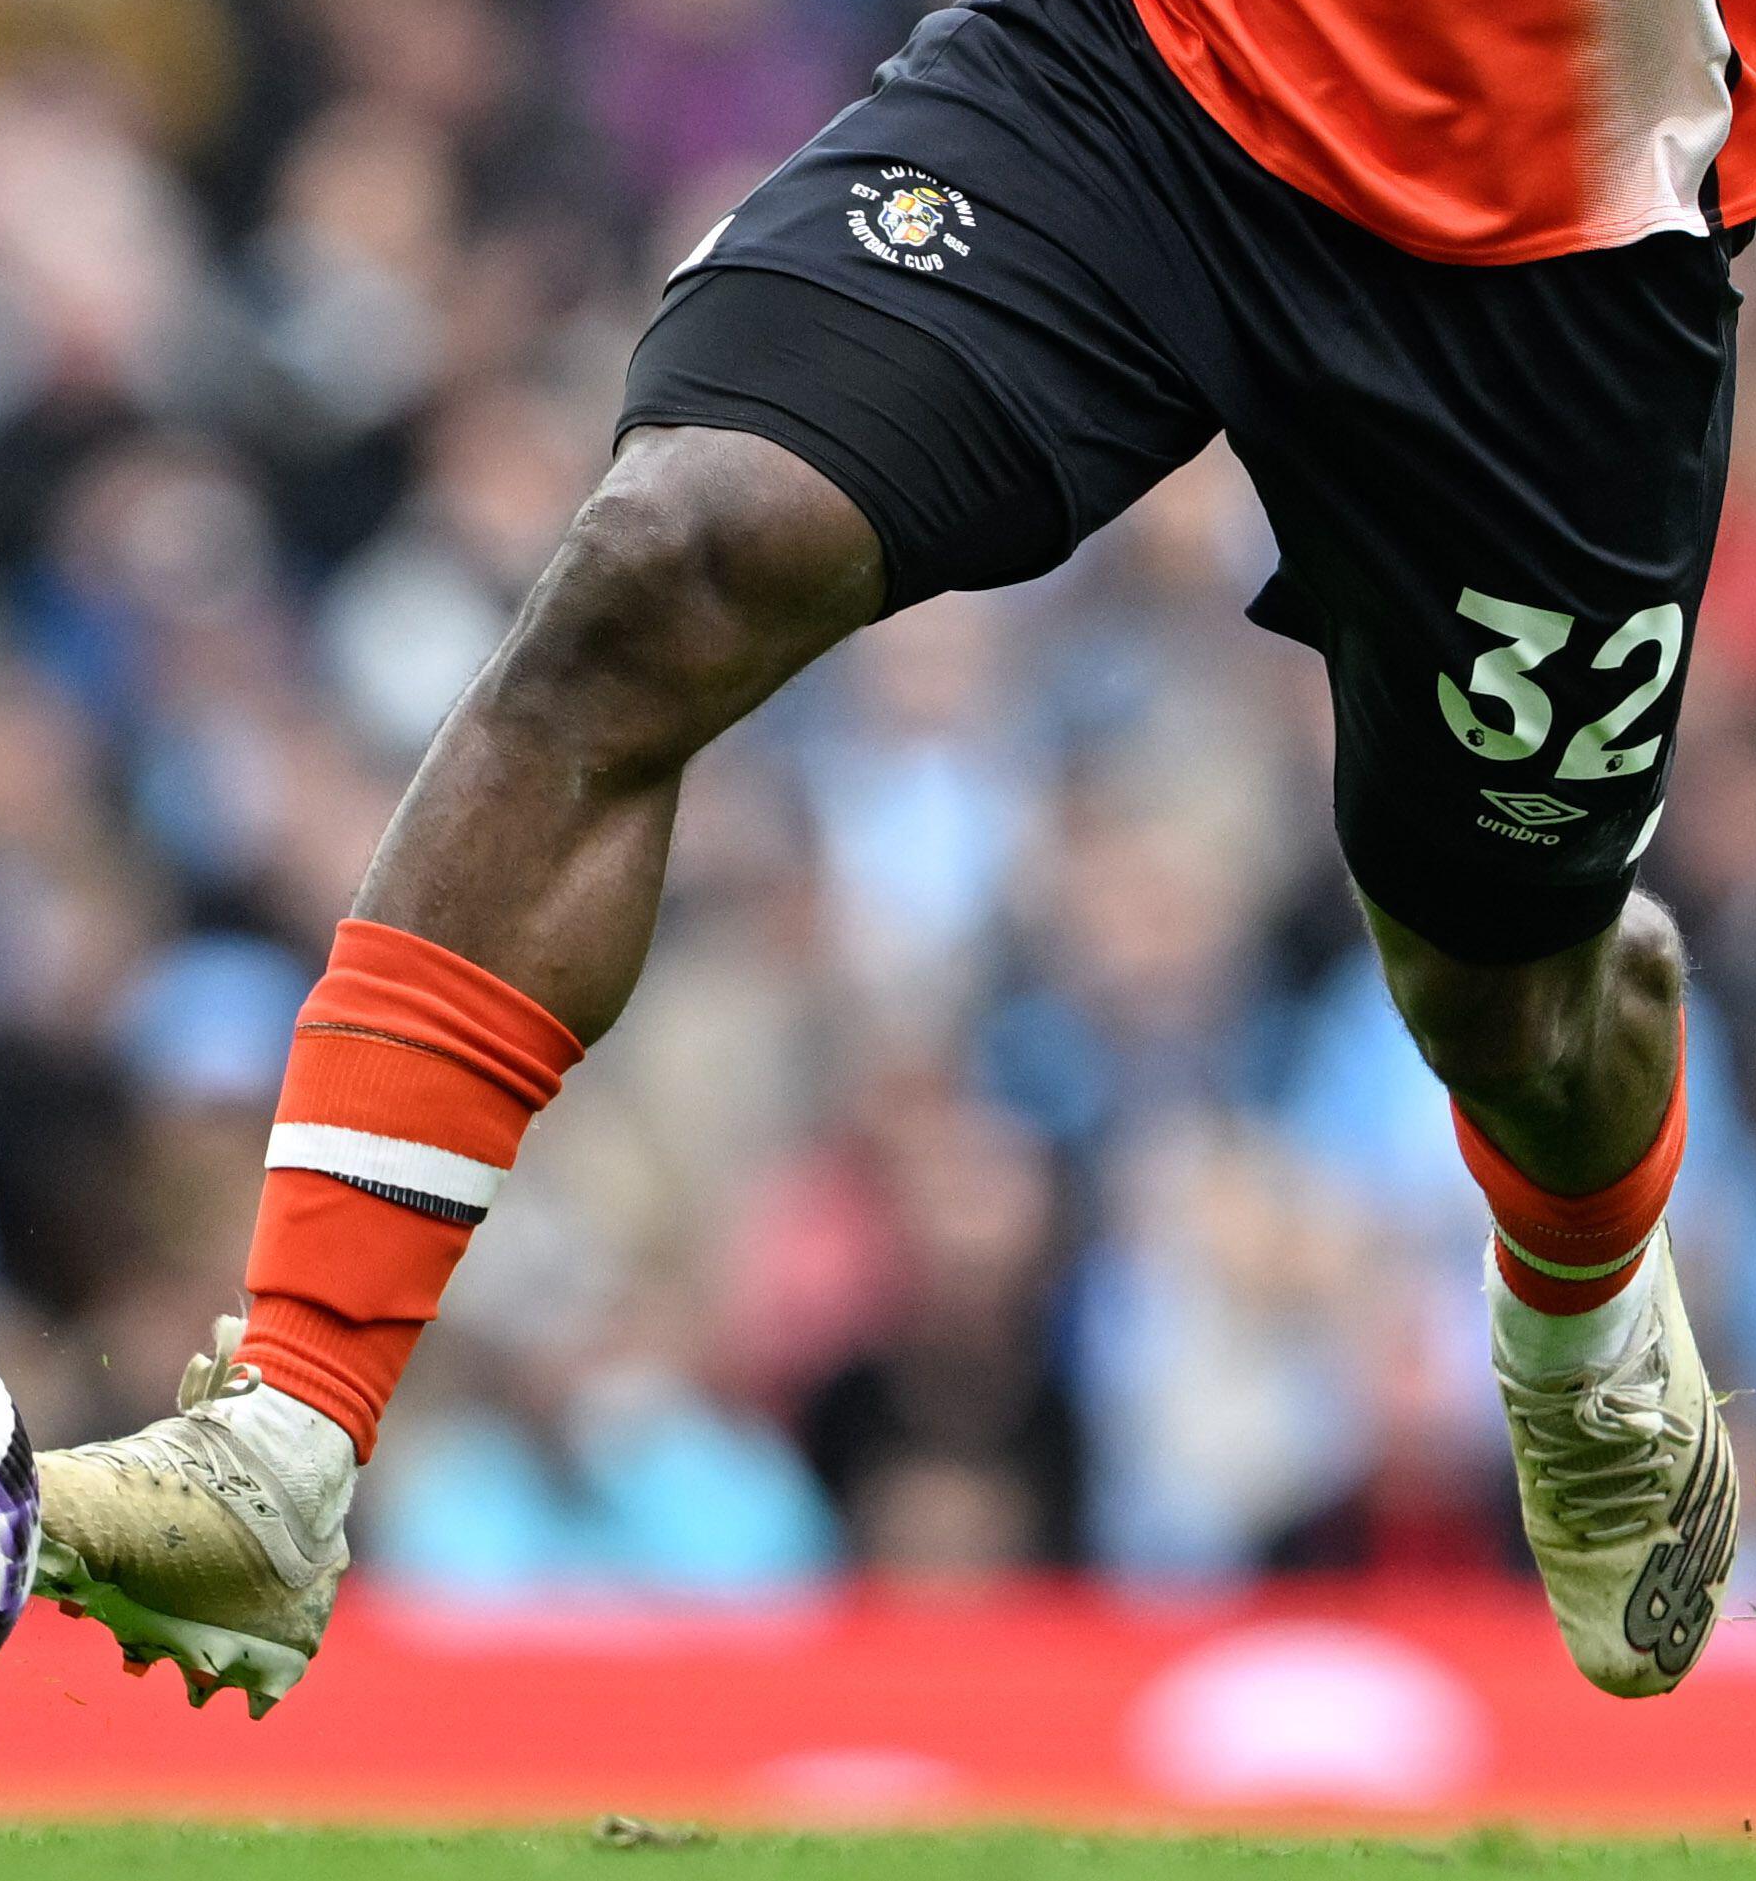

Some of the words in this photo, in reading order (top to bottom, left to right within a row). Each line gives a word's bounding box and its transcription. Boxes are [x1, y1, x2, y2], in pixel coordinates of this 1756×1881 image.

[850, 183, 881, 201] EST
[846, 209, 900, 264] FOOTBALL
[904, 253, 944, 271] CLUB
[942, 233, 971, 257] 1885
[1437, 586, 1683, 780] 32
[1476, 814, 1560, 846] umbro
